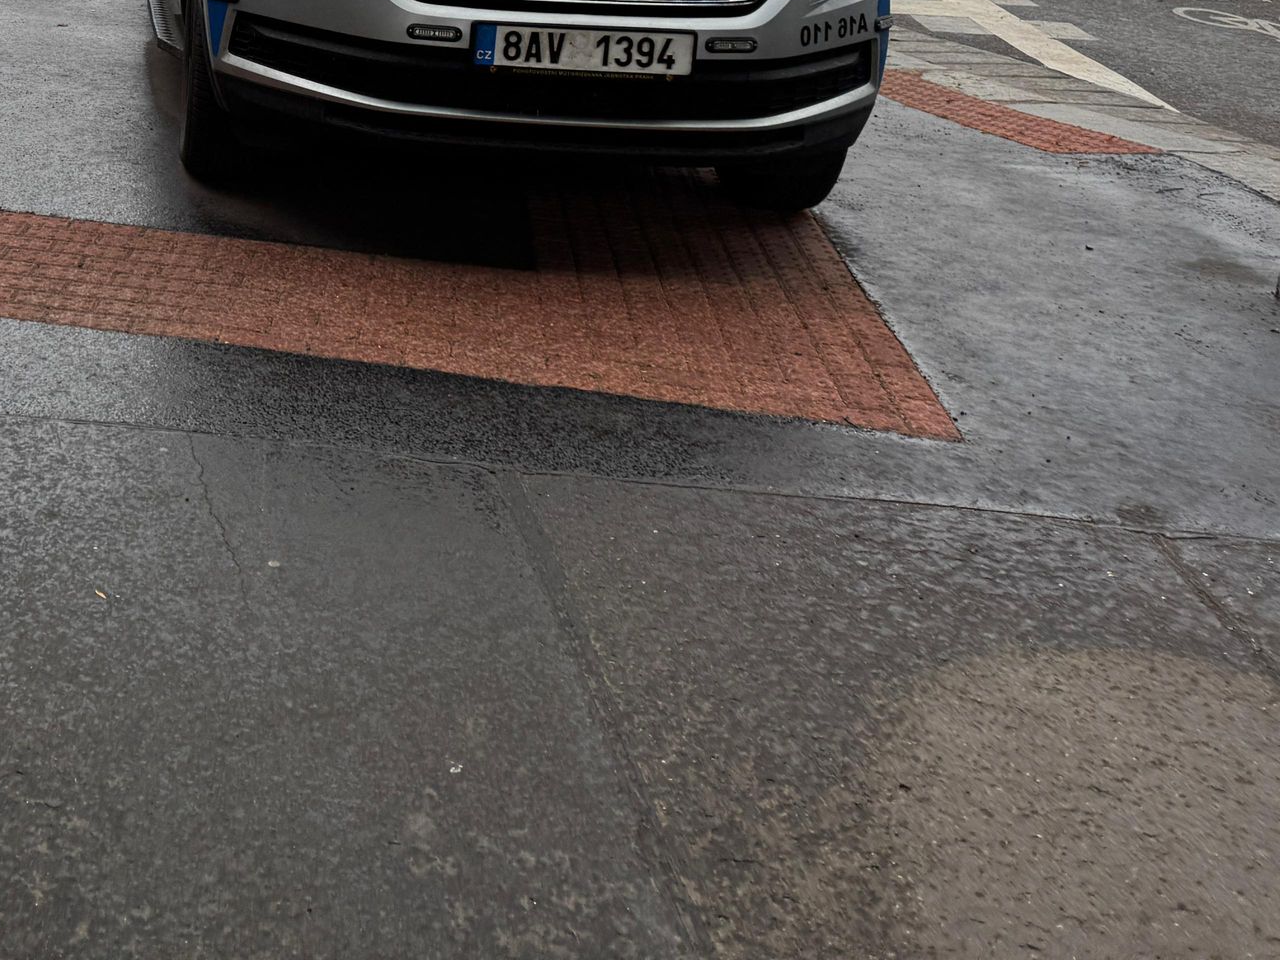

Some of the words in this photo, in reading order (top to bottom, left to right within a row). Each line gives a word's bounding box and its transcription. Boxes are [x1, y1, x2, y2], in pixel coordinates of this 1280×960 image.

[476, 50, 492, 60] CZ
[503, 30, 566, 65] 8AV
[596, 34, 676, 70] 1394
